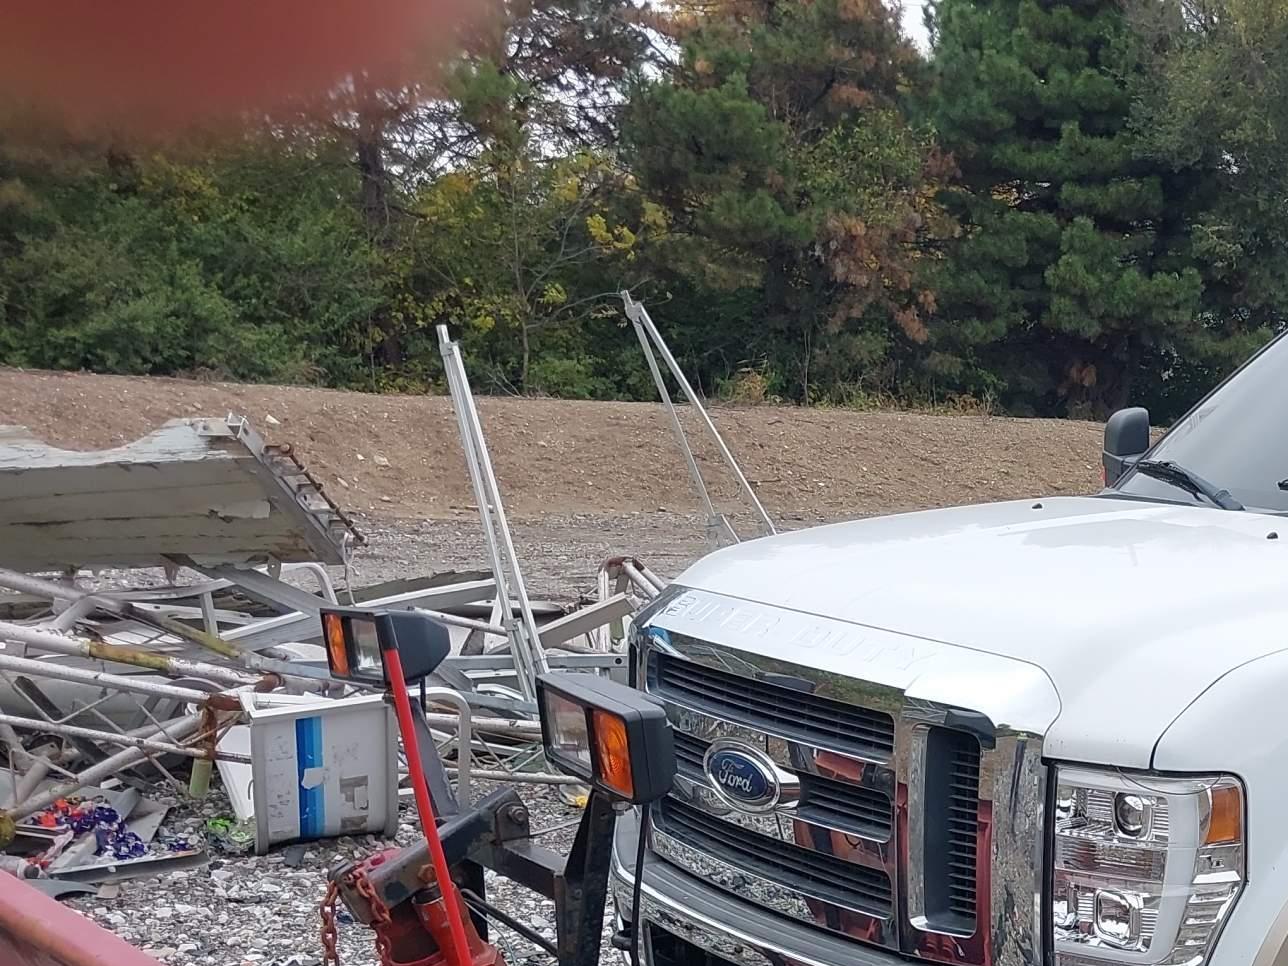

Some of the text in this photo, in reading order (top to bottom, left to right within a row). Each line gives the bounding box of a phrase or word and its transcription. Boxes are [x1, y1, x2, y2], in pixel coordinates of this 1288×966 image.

[665, 596, 938, 671] SUPER DUTY
[718, 758, 753, 792] Ford
